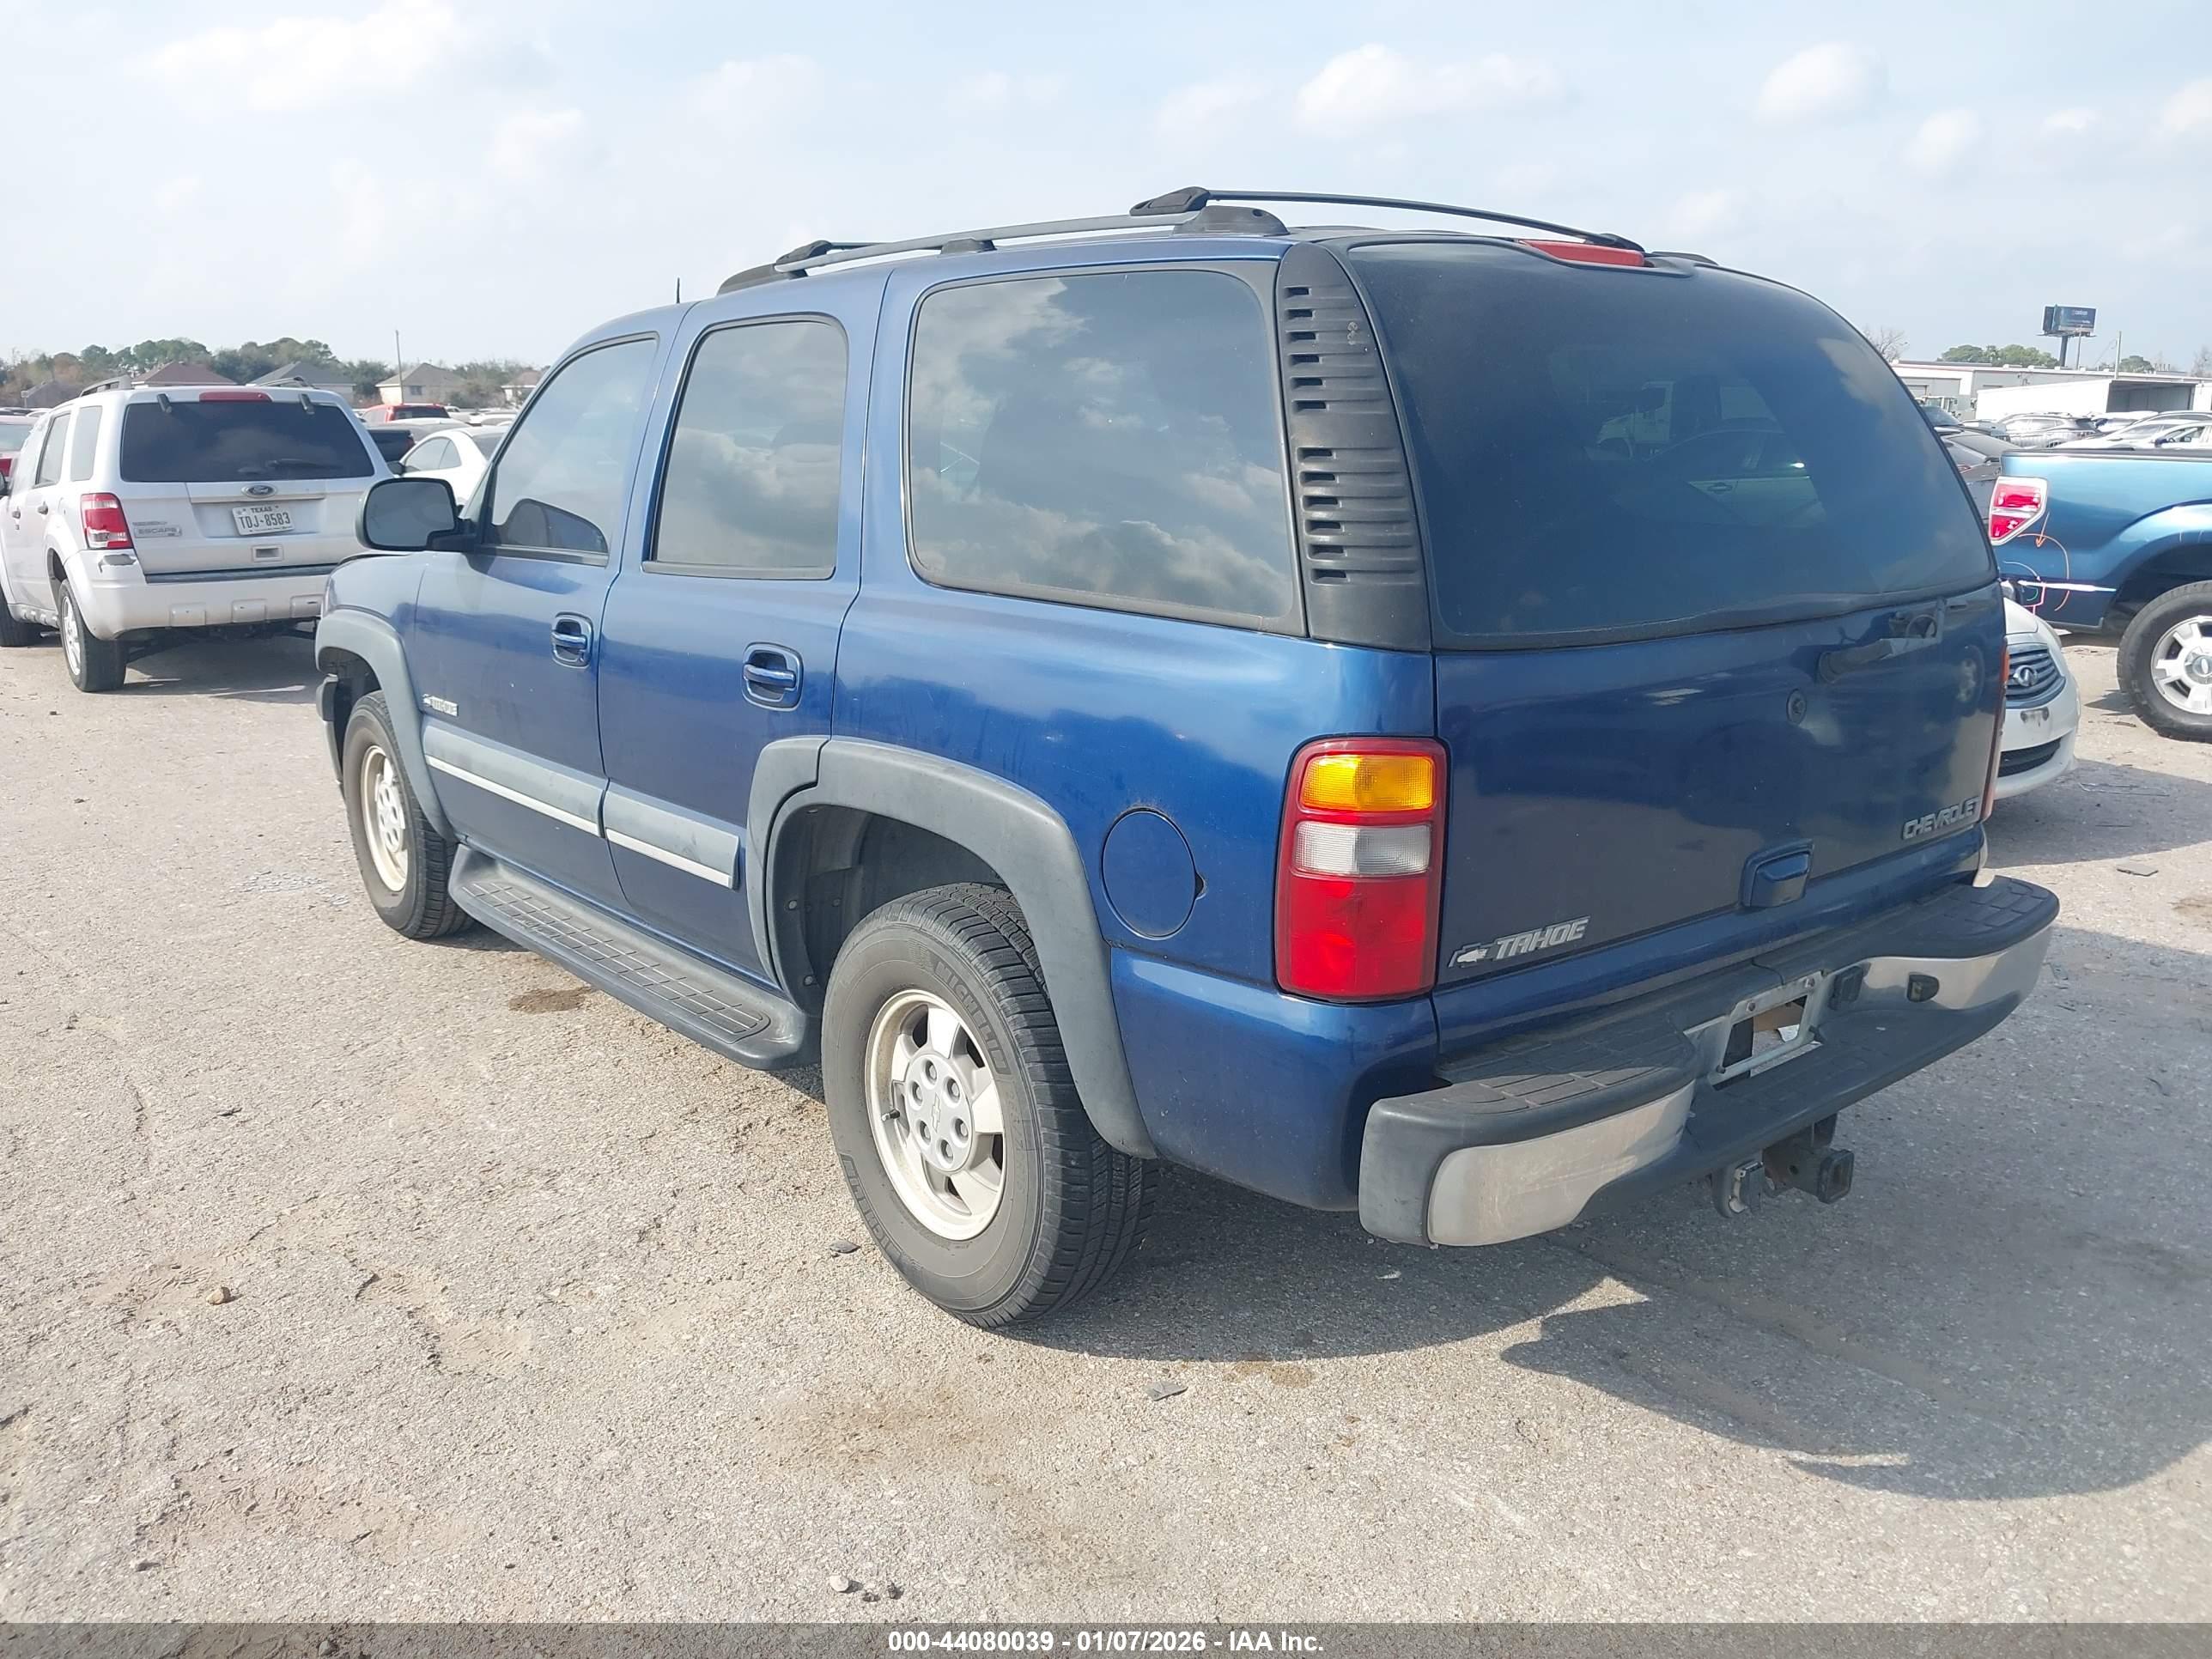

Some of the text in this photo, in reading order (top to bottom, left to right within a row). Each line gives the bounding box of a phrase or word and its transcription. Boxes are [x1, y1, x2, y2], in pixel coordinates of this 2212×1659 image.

[1901, 795, 1981, 840] CHEVROLET
[1496, 915, 1590, 960] TAHOE
[933, 960, 1007, 1070] MICHELIN
